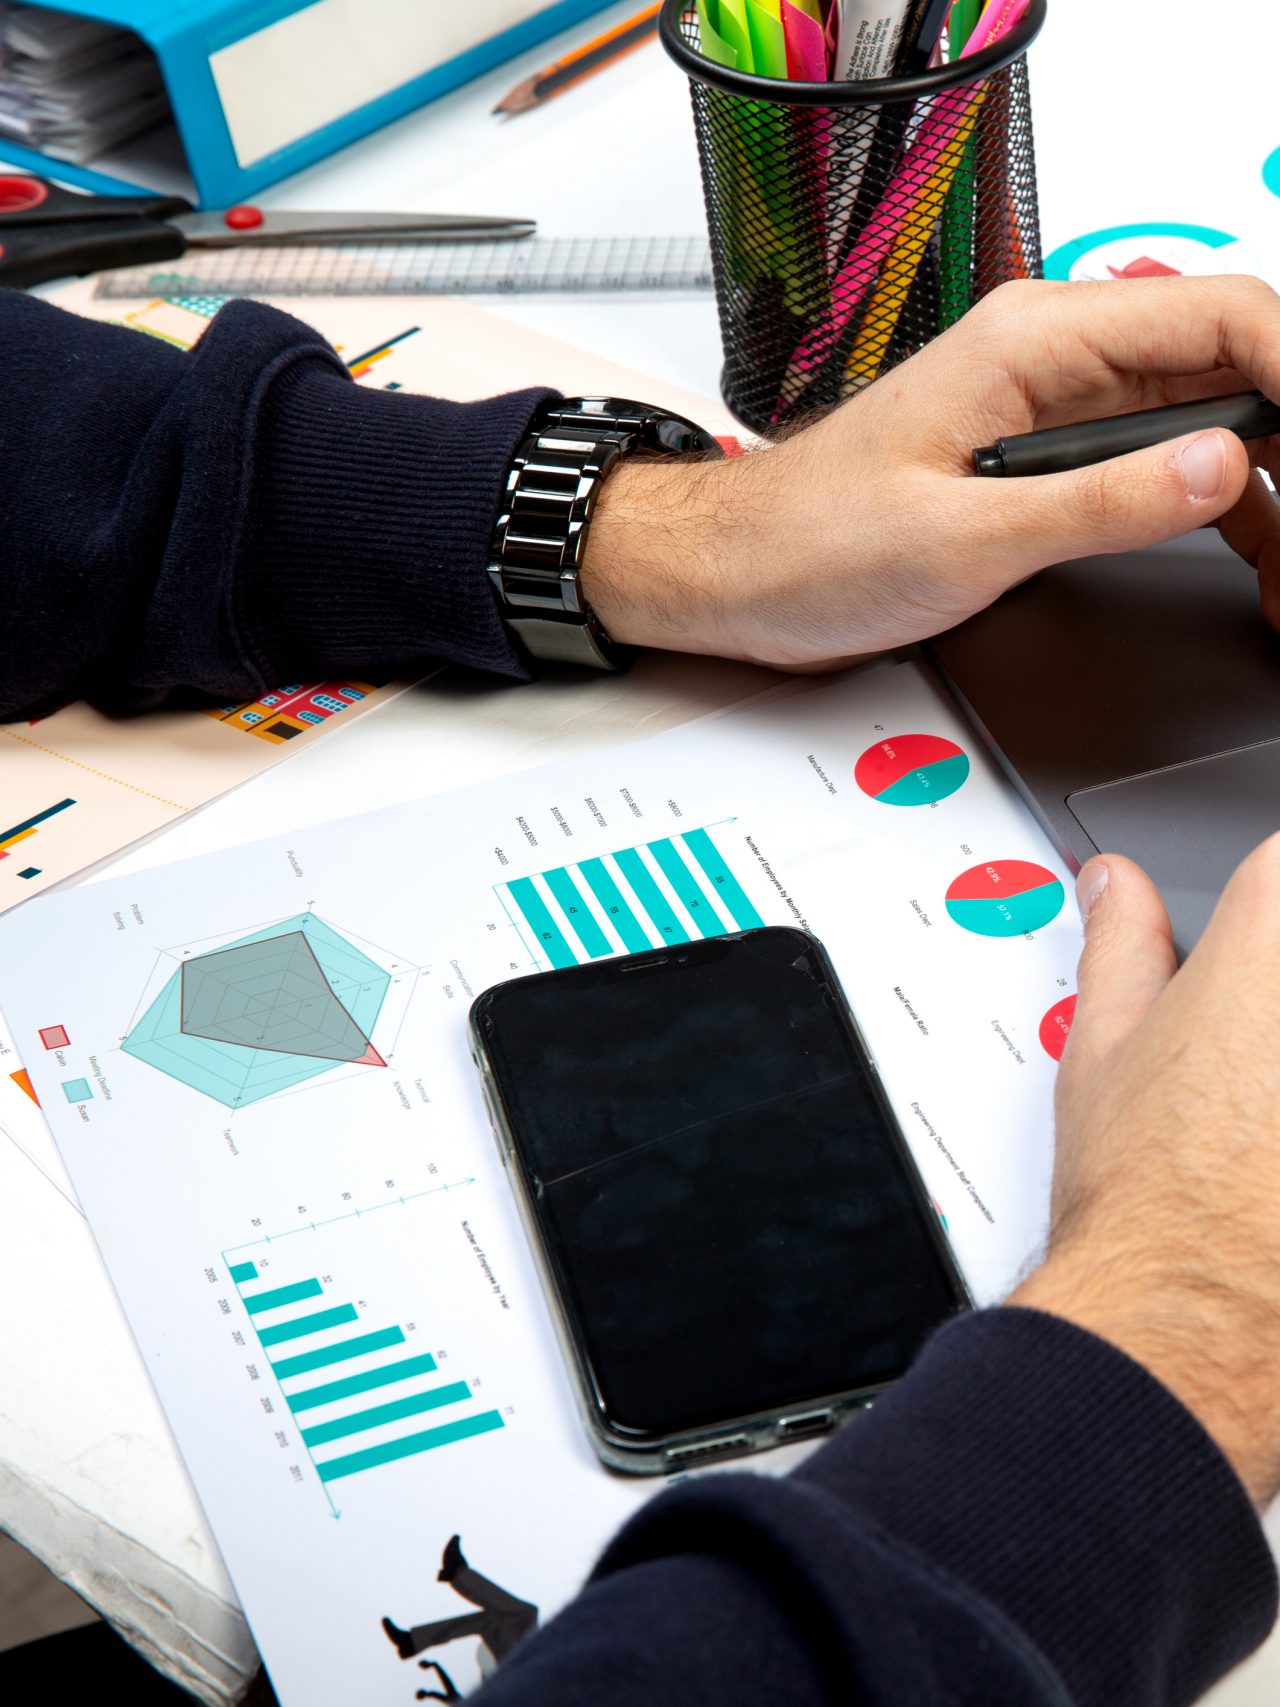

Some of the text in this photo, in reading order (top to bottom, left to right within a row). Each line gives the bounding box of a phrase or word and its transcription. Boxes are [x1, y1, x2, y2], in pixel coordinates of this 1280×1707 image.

[807, 755, 828, 782] Manufacture
[960, 845, 972, 855] 600
[745, 836, 760, 856] Number
[762, 863, 783, 890] Employees
[785, 898, 801, 918] Monthly
[986, 867, 1000, 882] 42.9%
[689, 899, 699, 907] 70
[910, 900, 922, 914] Sales
[997, 905, 1012, 920] 57.1%
[487, 922, 496, 930] 20
[1056, 978, 1067, 986] 28
[893, 987, 928, 1035] Male/Female Ratio
[991, 1020, 1015, 1051] Engineering
[55, 1051, 66, 1066] Calvin
[88, 1056, 112, 1100] Meeting Deadline
[78, 1105, 90, 1122] Susan
[911, 1102, 995, 1224] Engineering Department Staff Composition
[462, 1221, 477, 1244] Number
[500, 1295, 509, 1309] Year
[204, 1268, 218, 1283] 2005
